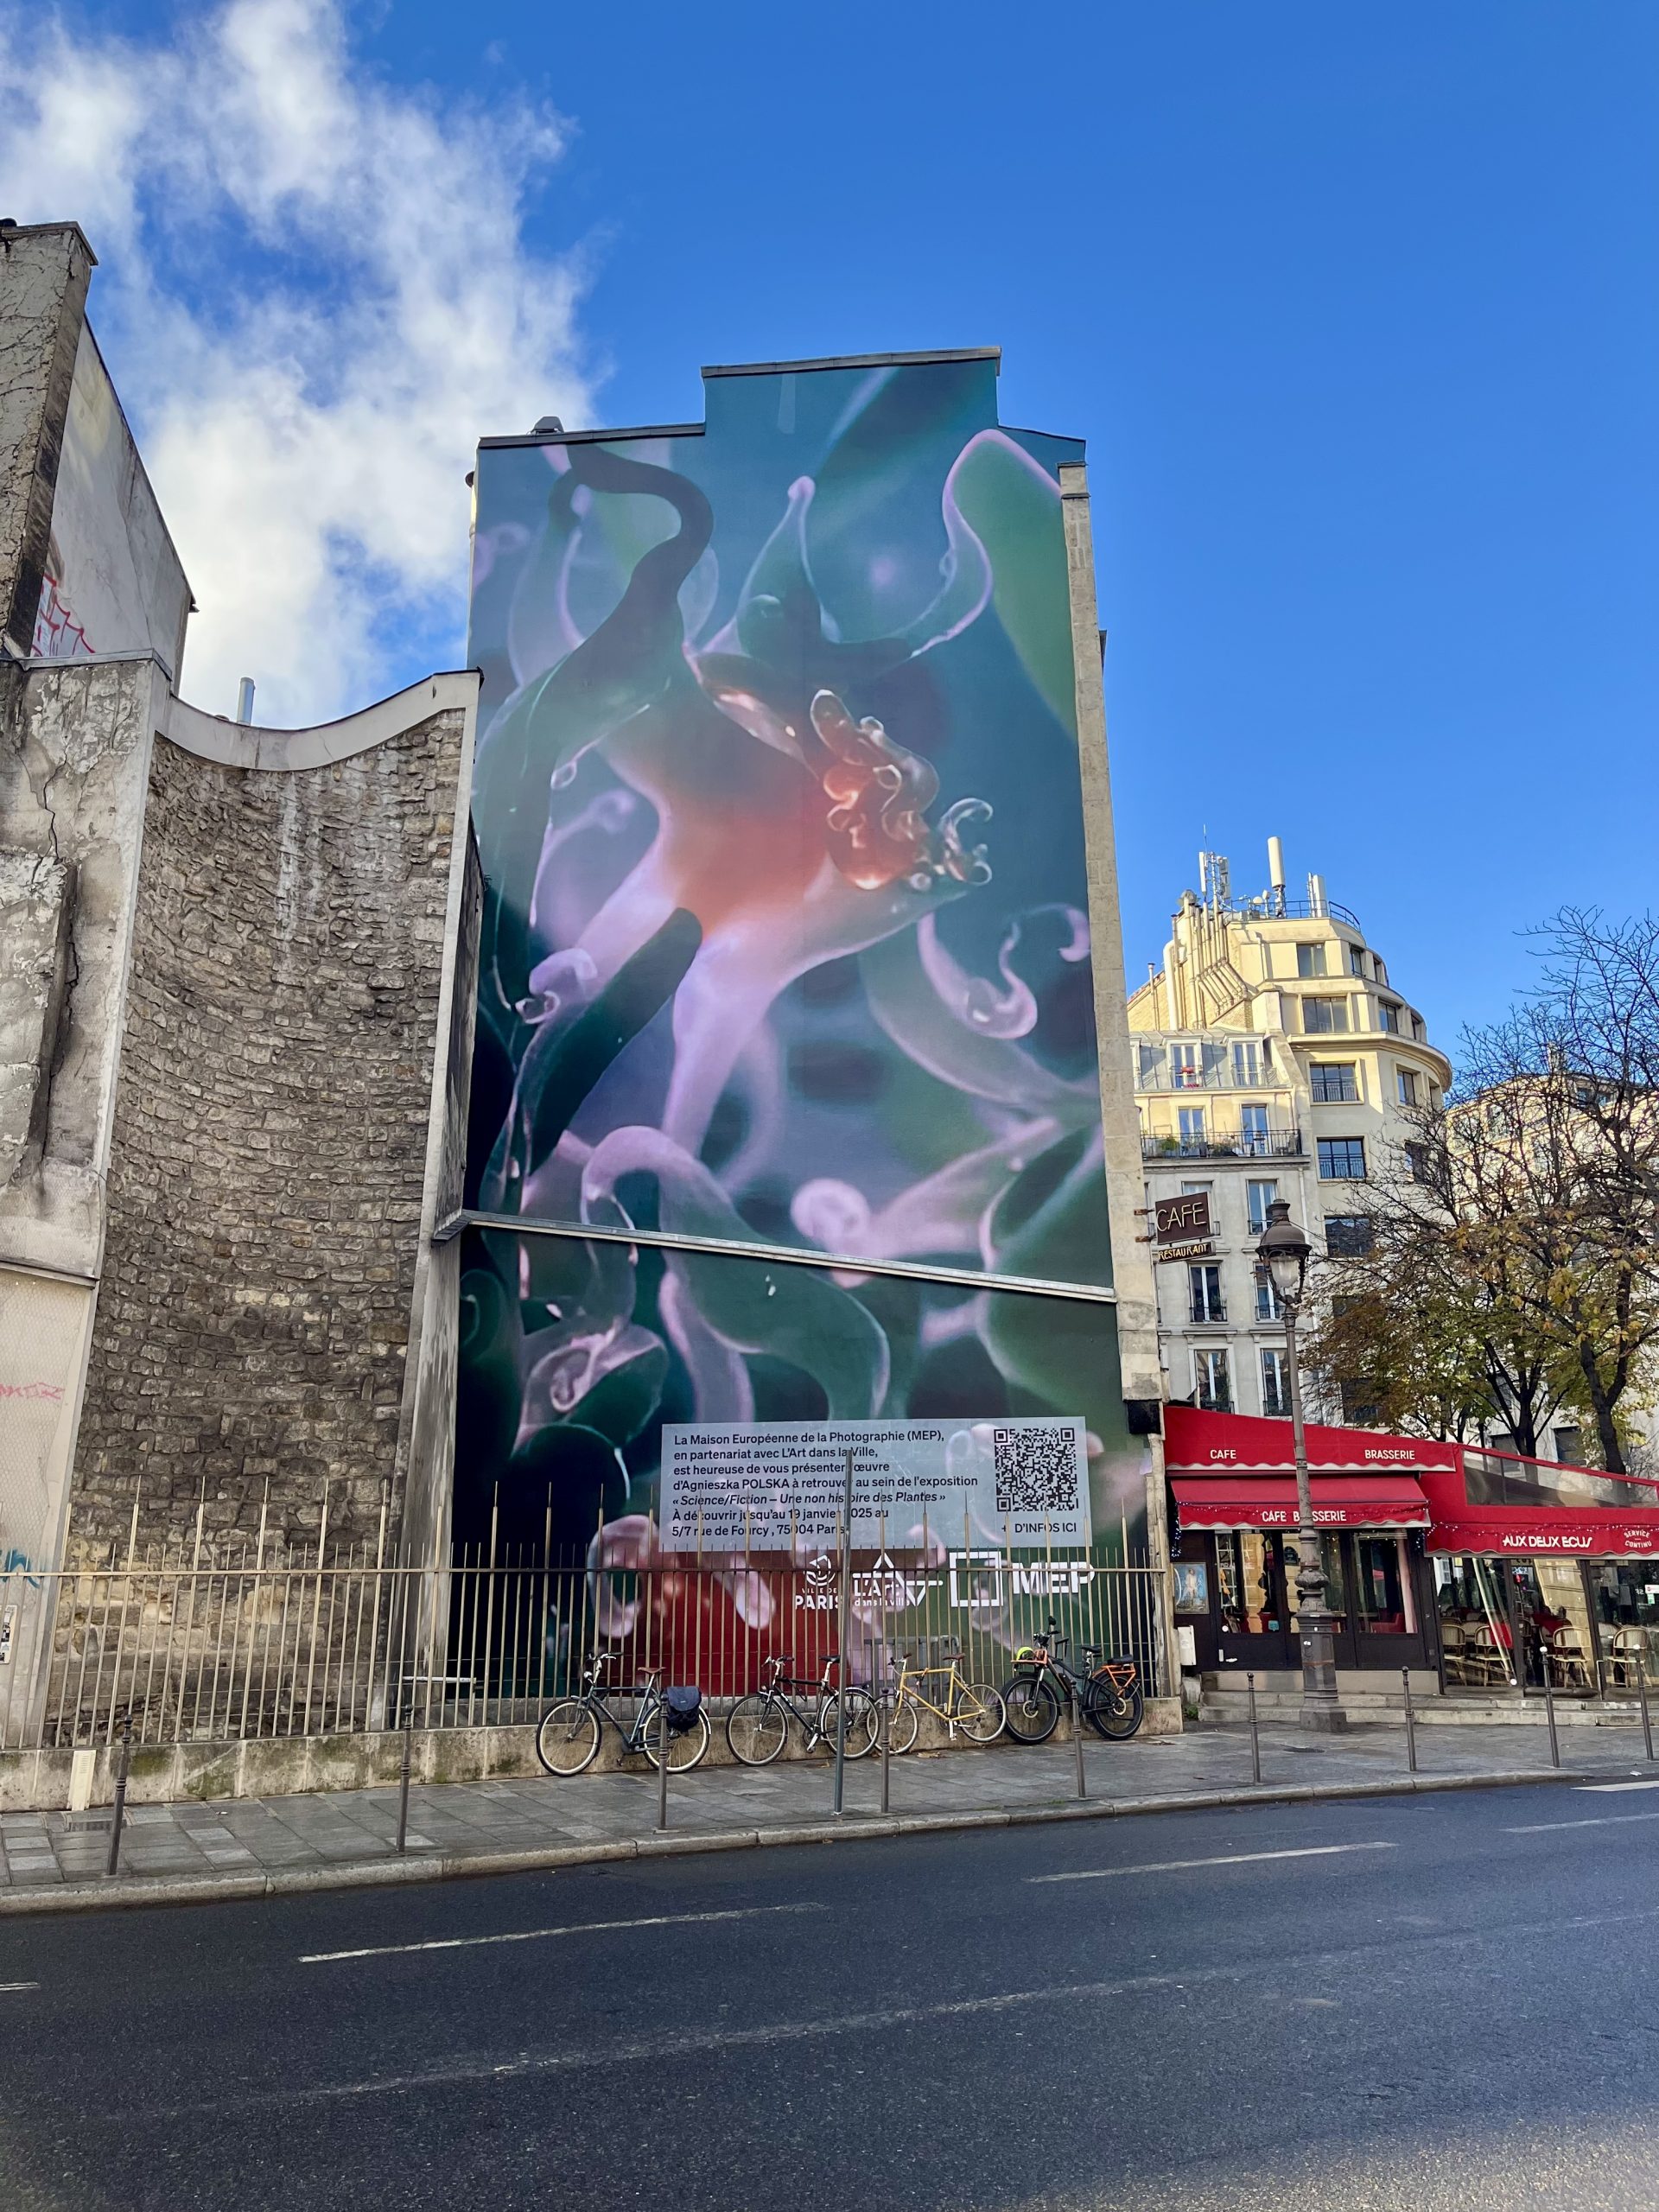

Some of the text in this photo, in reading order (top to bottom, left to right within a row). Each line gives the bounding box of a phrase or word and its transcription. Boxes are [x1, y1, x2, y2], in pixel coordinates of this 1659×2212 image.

[1156, 1202, 1206, 1231] CAFE
[1159, 1243, 1208, 1260] RESTAURANT
[674, 1430, 944, 1446] La Maison Européenne de la Photographie (MEP),
[674, 1446, 878, 1462] en partenariat avec L'Art dans la Ville,
[1210, 1449, 1236, 1459] CAFE
[1364, 1449, 1415, 1460] BRASSERIE
[673, 1465, 690, 1475] est
[693, 1465, 744, 1475] heureuse
[747, 1464, 760, 1474] de
[763, 1465, 789, 1473] vous
[791, 1462, 845, 1475] présenter
[673, 1479, 740, 1492] d'Agnieszka
[742, 1478, 790, 1489] POLSKA
[792, 1478, 799, 1488] à
[802, 1478, 853, 1488] retrouve
[872, 1477, 895, 1487] sein
[897, 1477, 912, 1486] de
[914, 1475, 978, 1488] l'exposition
[680, 1494, 767, 1506] Science/Fiction
[780, 1493, 802, 1504] Une
[804, 1495, 825, 1503] non
[828, 1492, 870, 1503] hisoire
[873, 1491, 893, 1503] des
[895, 1491, 938, 1503] Plantes
[672, 1508, 681, 1521] À
[788, 1509, 801, 1519] 19
[803, 1508, 837, 1521] janvie
[845, 1507, 873, 1518] 025
[874, 1510, 889, 1518] au
[1262, 1510, 1347, 1522] CAFE BSSERIE
[671, 1525, 692, 1537] 5/7
[715, 1525, 728, 1536] de
[1062, 1522, 1077, 1533] ICI
[1624, 1529, 1650, 1538] SERVICE
[1502, 1535, 1592, 1548] AUX DEUX ECUS
[1624, 1540, 1652, 1548] CONTINU
[1012, 1561, 1096, 1594] MEP
